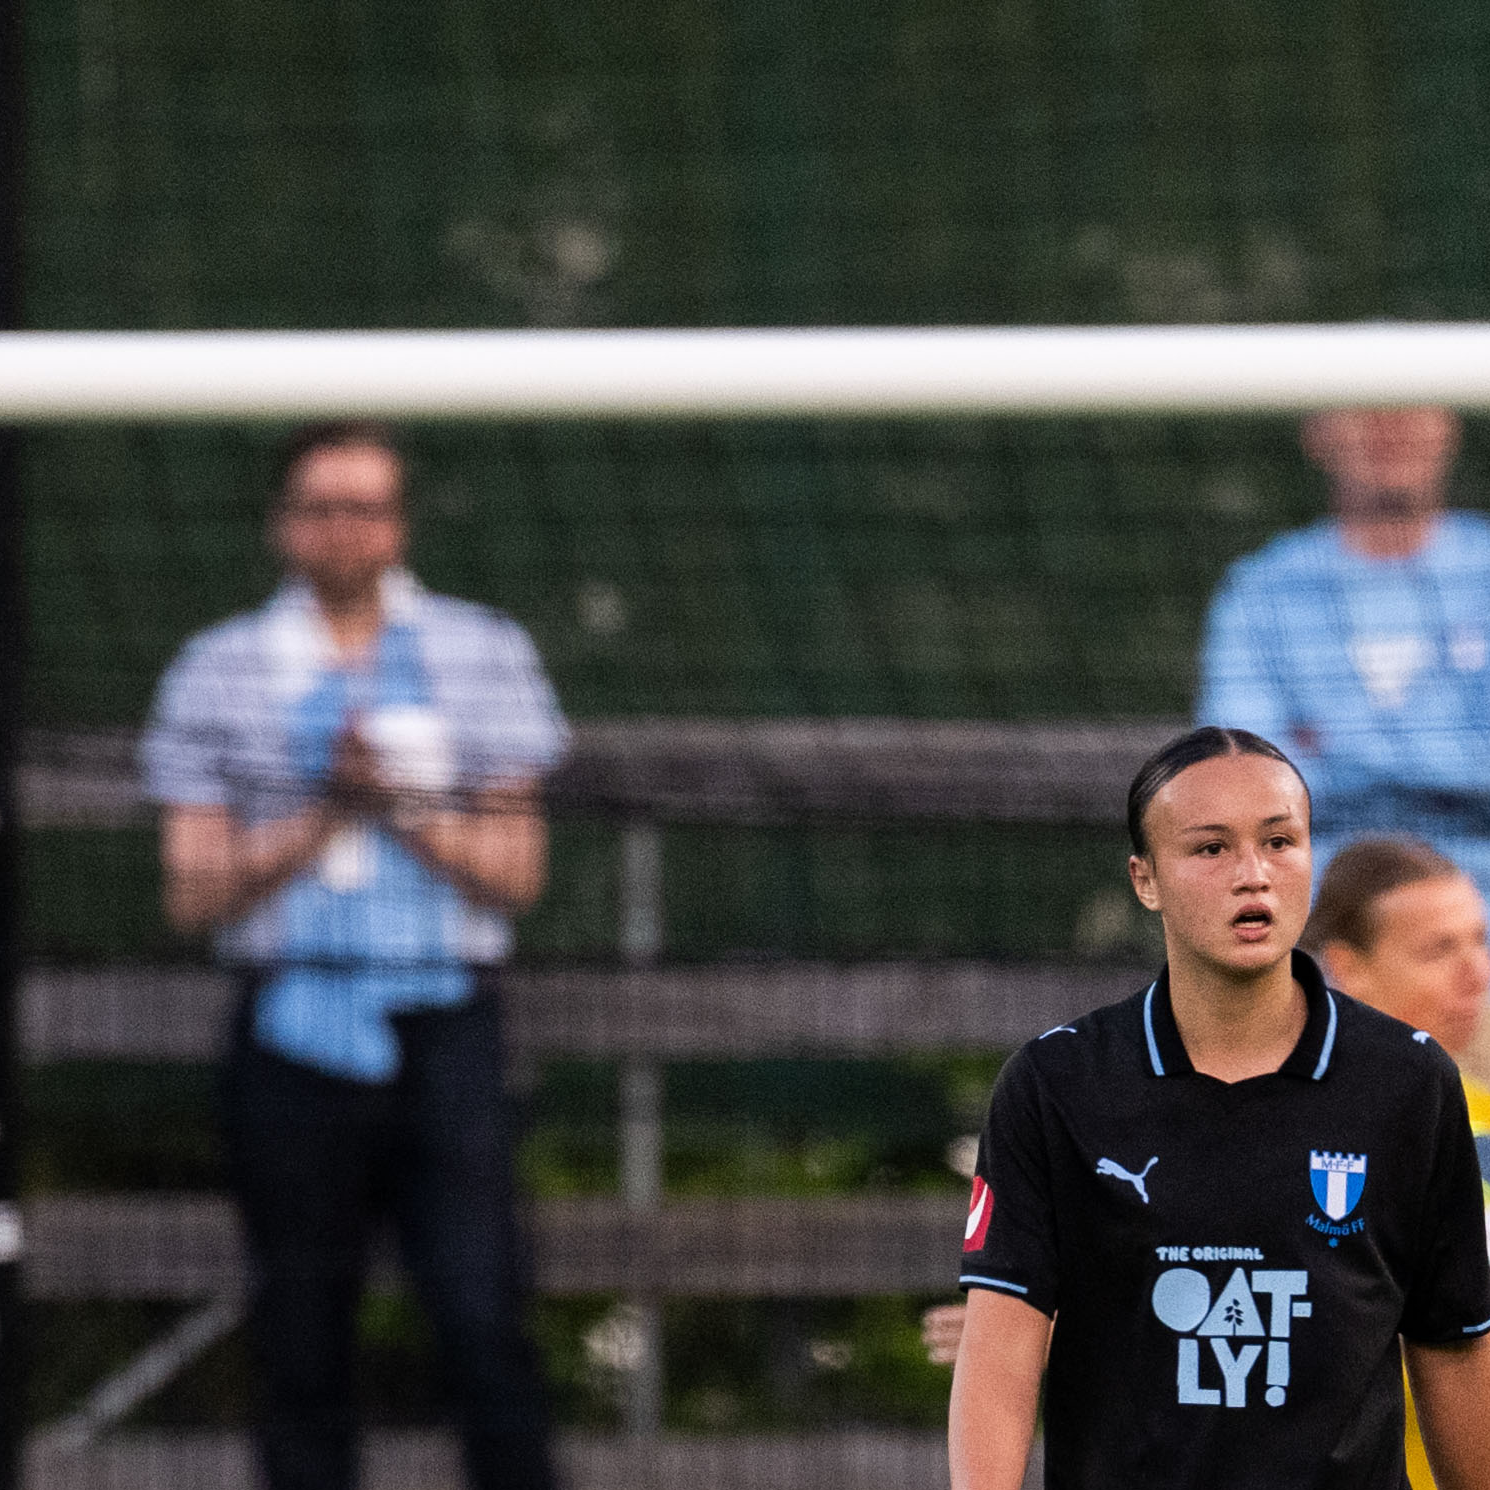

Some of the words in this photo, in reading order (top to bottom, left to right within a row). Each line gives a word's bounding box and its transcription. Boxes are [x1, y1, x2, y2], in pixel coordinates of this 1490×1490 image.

[1305, 1213, 1350, 1236] Malmö
[1351, 1218, 1366, 1234] FF
[1156, 1247, 1190, 1261] THE
[1192, 1246, 1264, 1261] ORIGINAL
[1152, 1267, 1312, 1338] OAT-
[1177, 1337, 1290, 1408] LY!
